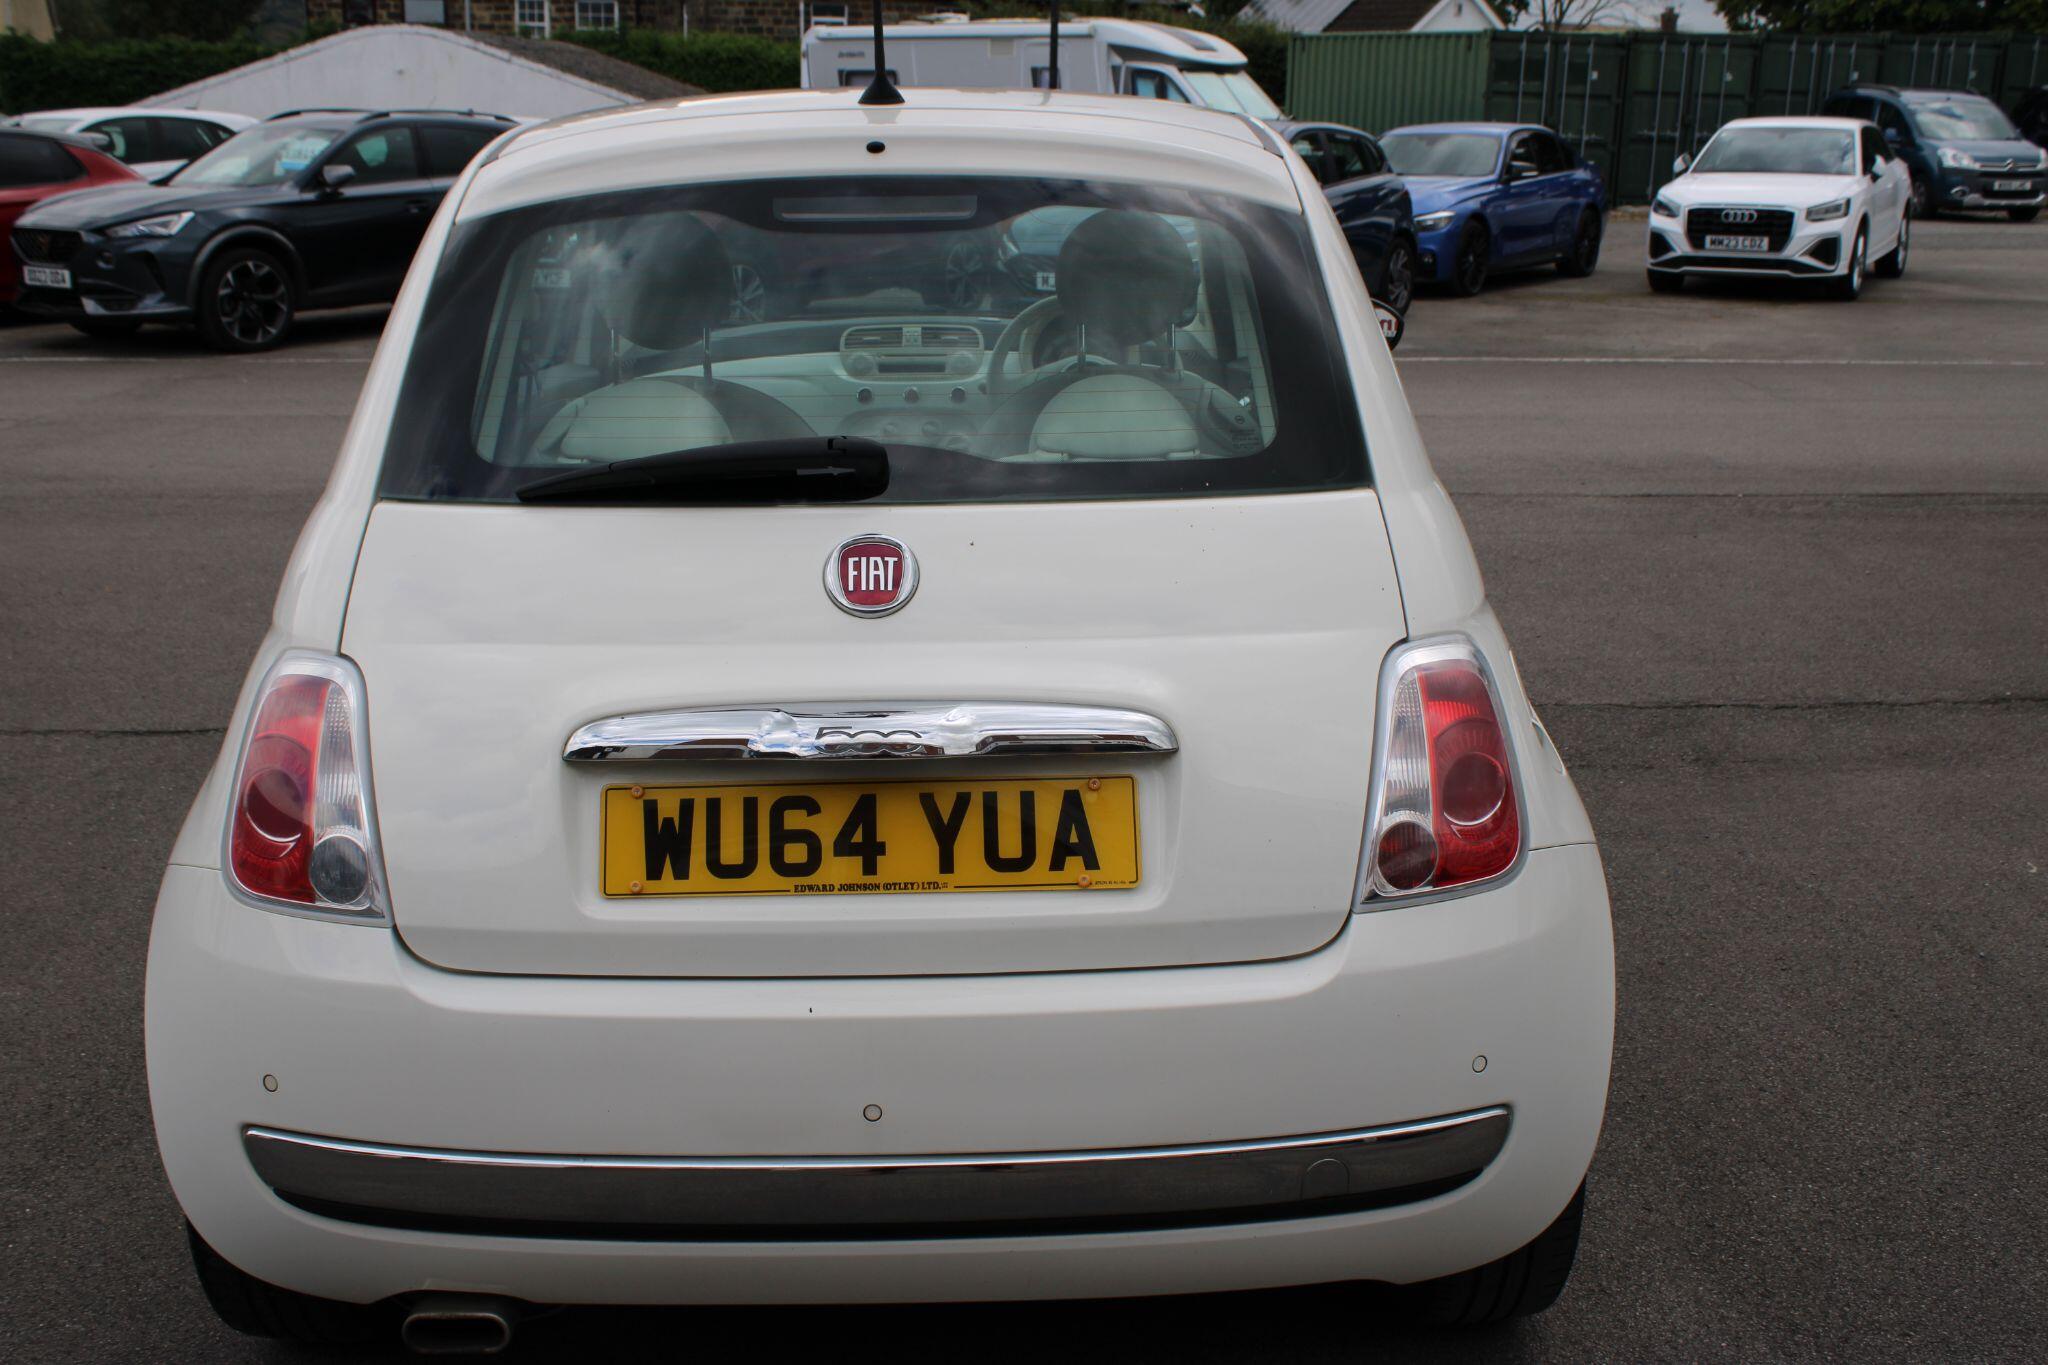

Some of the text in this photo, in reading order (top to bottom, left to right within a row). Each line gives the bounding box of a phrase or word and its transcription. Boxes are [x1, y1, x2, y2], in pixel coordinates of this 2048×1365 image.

[848, 556, 898, 591] FIAT
[643, 789, 1100, 881] WU64 YUA
[793, 883, 835, 893] EDWARD
[837, 882, 881, 892] JOHNSON
[882, 881, 920, 892] (OTLEY)
[921, 881, 942, 890] LTD.
